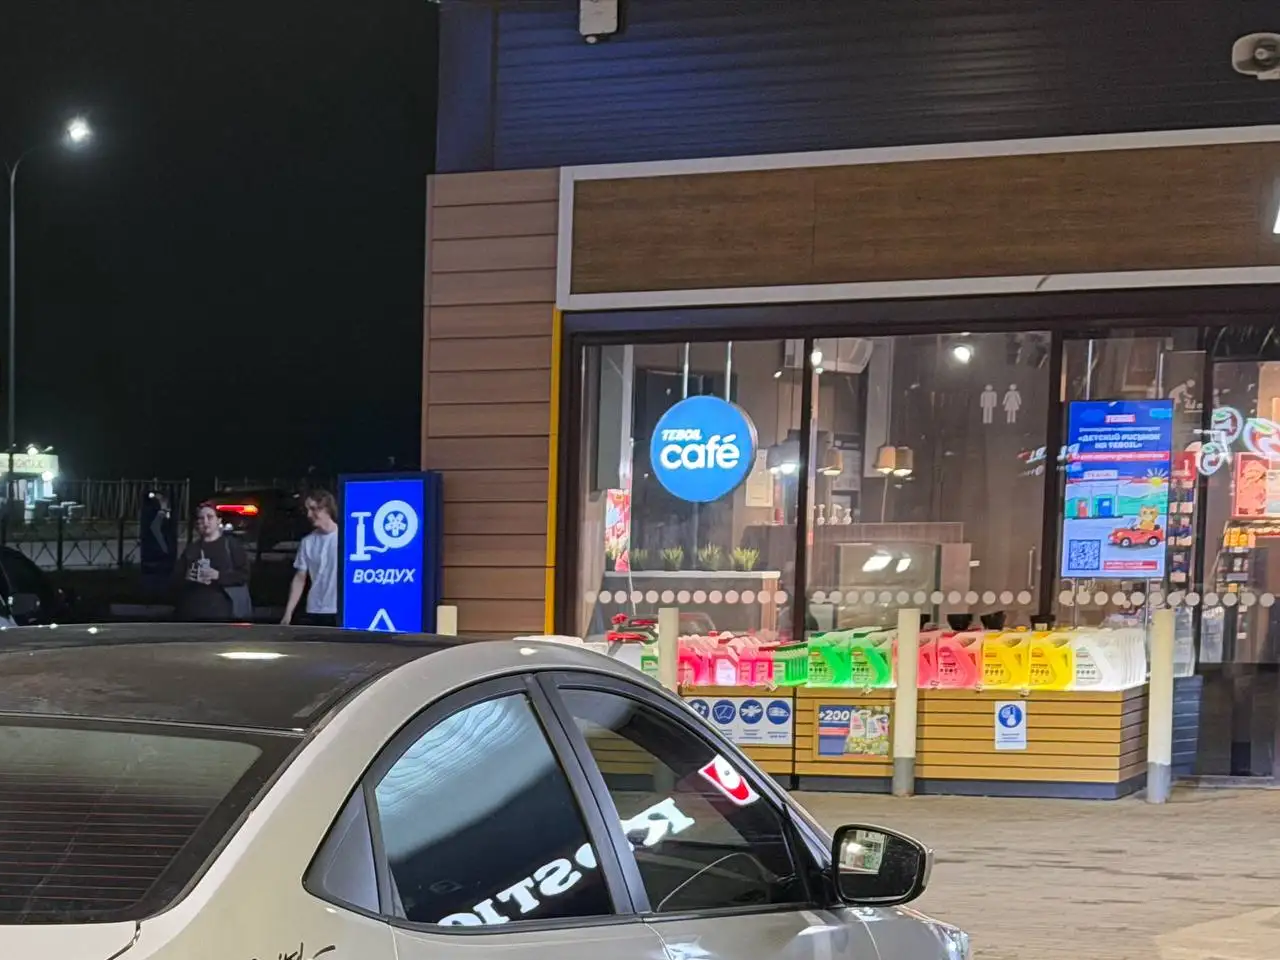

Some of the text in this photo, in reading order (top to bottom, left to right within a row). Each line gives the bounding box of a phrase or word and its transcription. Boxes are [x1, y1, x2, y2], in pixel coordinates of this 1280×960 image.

[661, 434, 740, 470] café
[353, 568, 416, 585] ВОЗДУХ
[818, 709, 850, 721] +200
